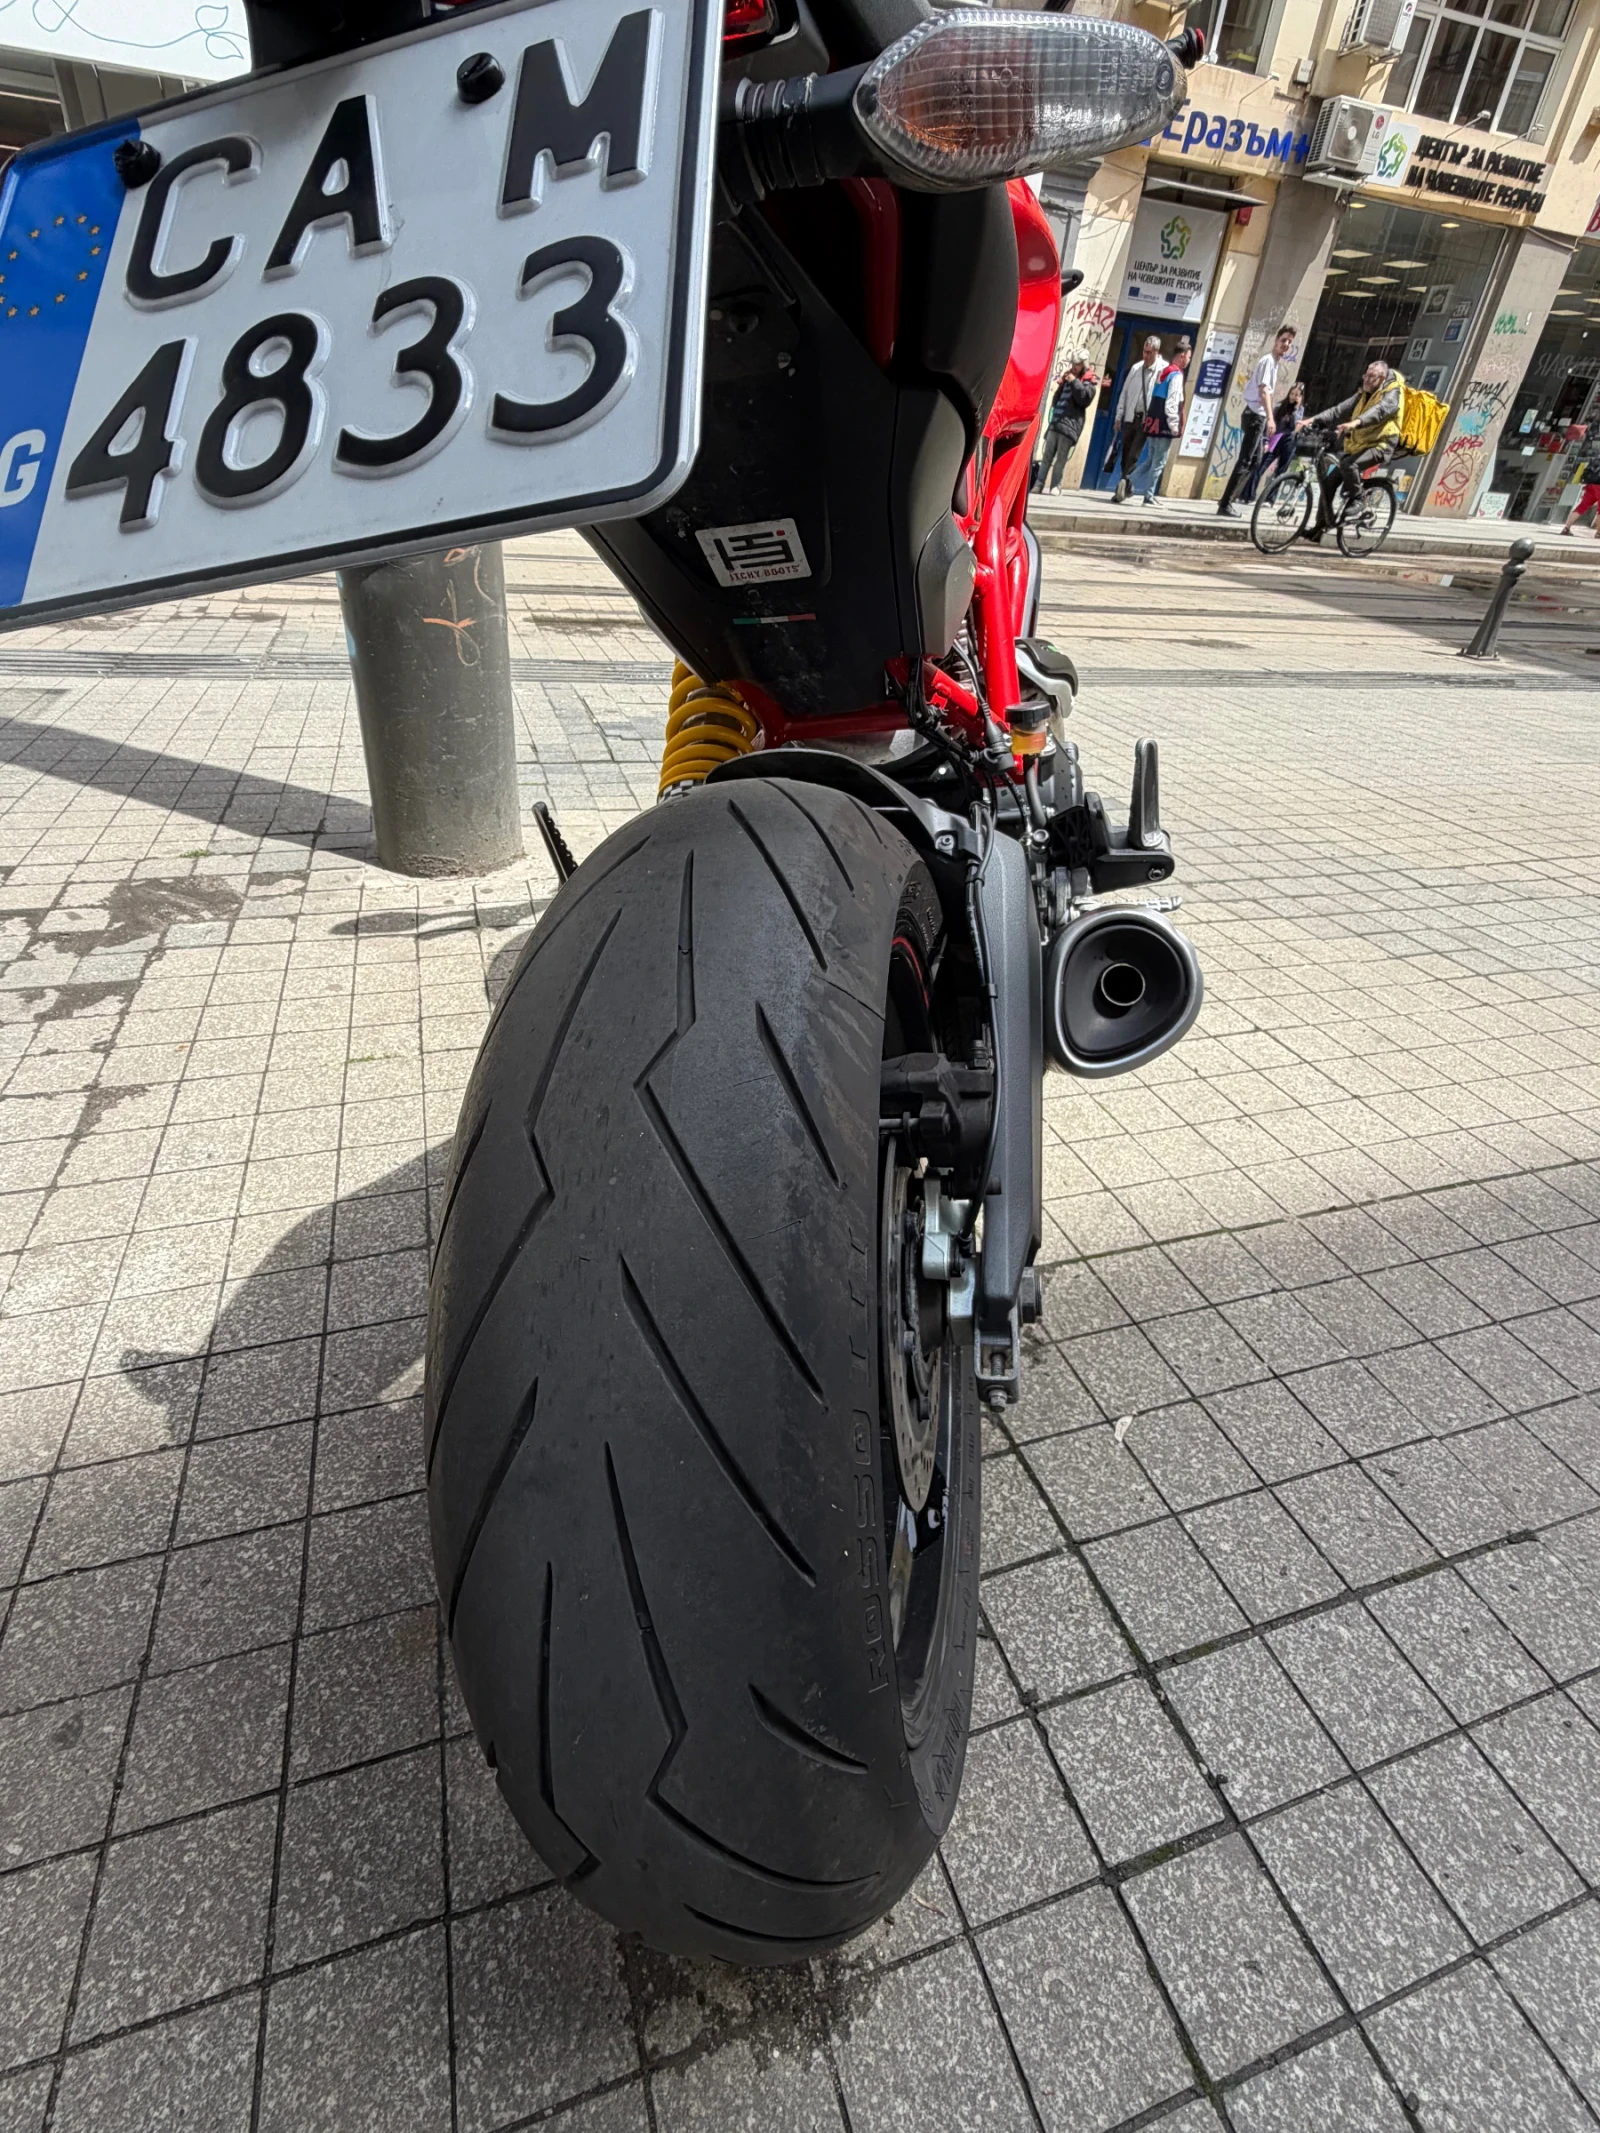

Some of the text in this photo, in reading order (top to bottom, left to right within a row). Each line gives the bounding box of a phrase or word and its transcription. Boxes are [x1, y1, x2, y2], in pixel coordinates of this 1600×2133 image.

[1371, 131, 1380, 139] LG
[1416, 135, 1469, 165] ЦЕНТЪР
[1467, 147, 1486, 170] ЗА
[1134, 260, 1202, 280] ЦЕНТЪР ЗА РАЗВИТИЕ
[1128, 271, 1203, 291] НА ЧОВЕШКИТЕ РЕСУРСИ
[65, 235, 637, 530] 4833
[730, 565, 799, 581] ITCHY BOOTS
[850, 1408, 889, 1693] ROSSO
